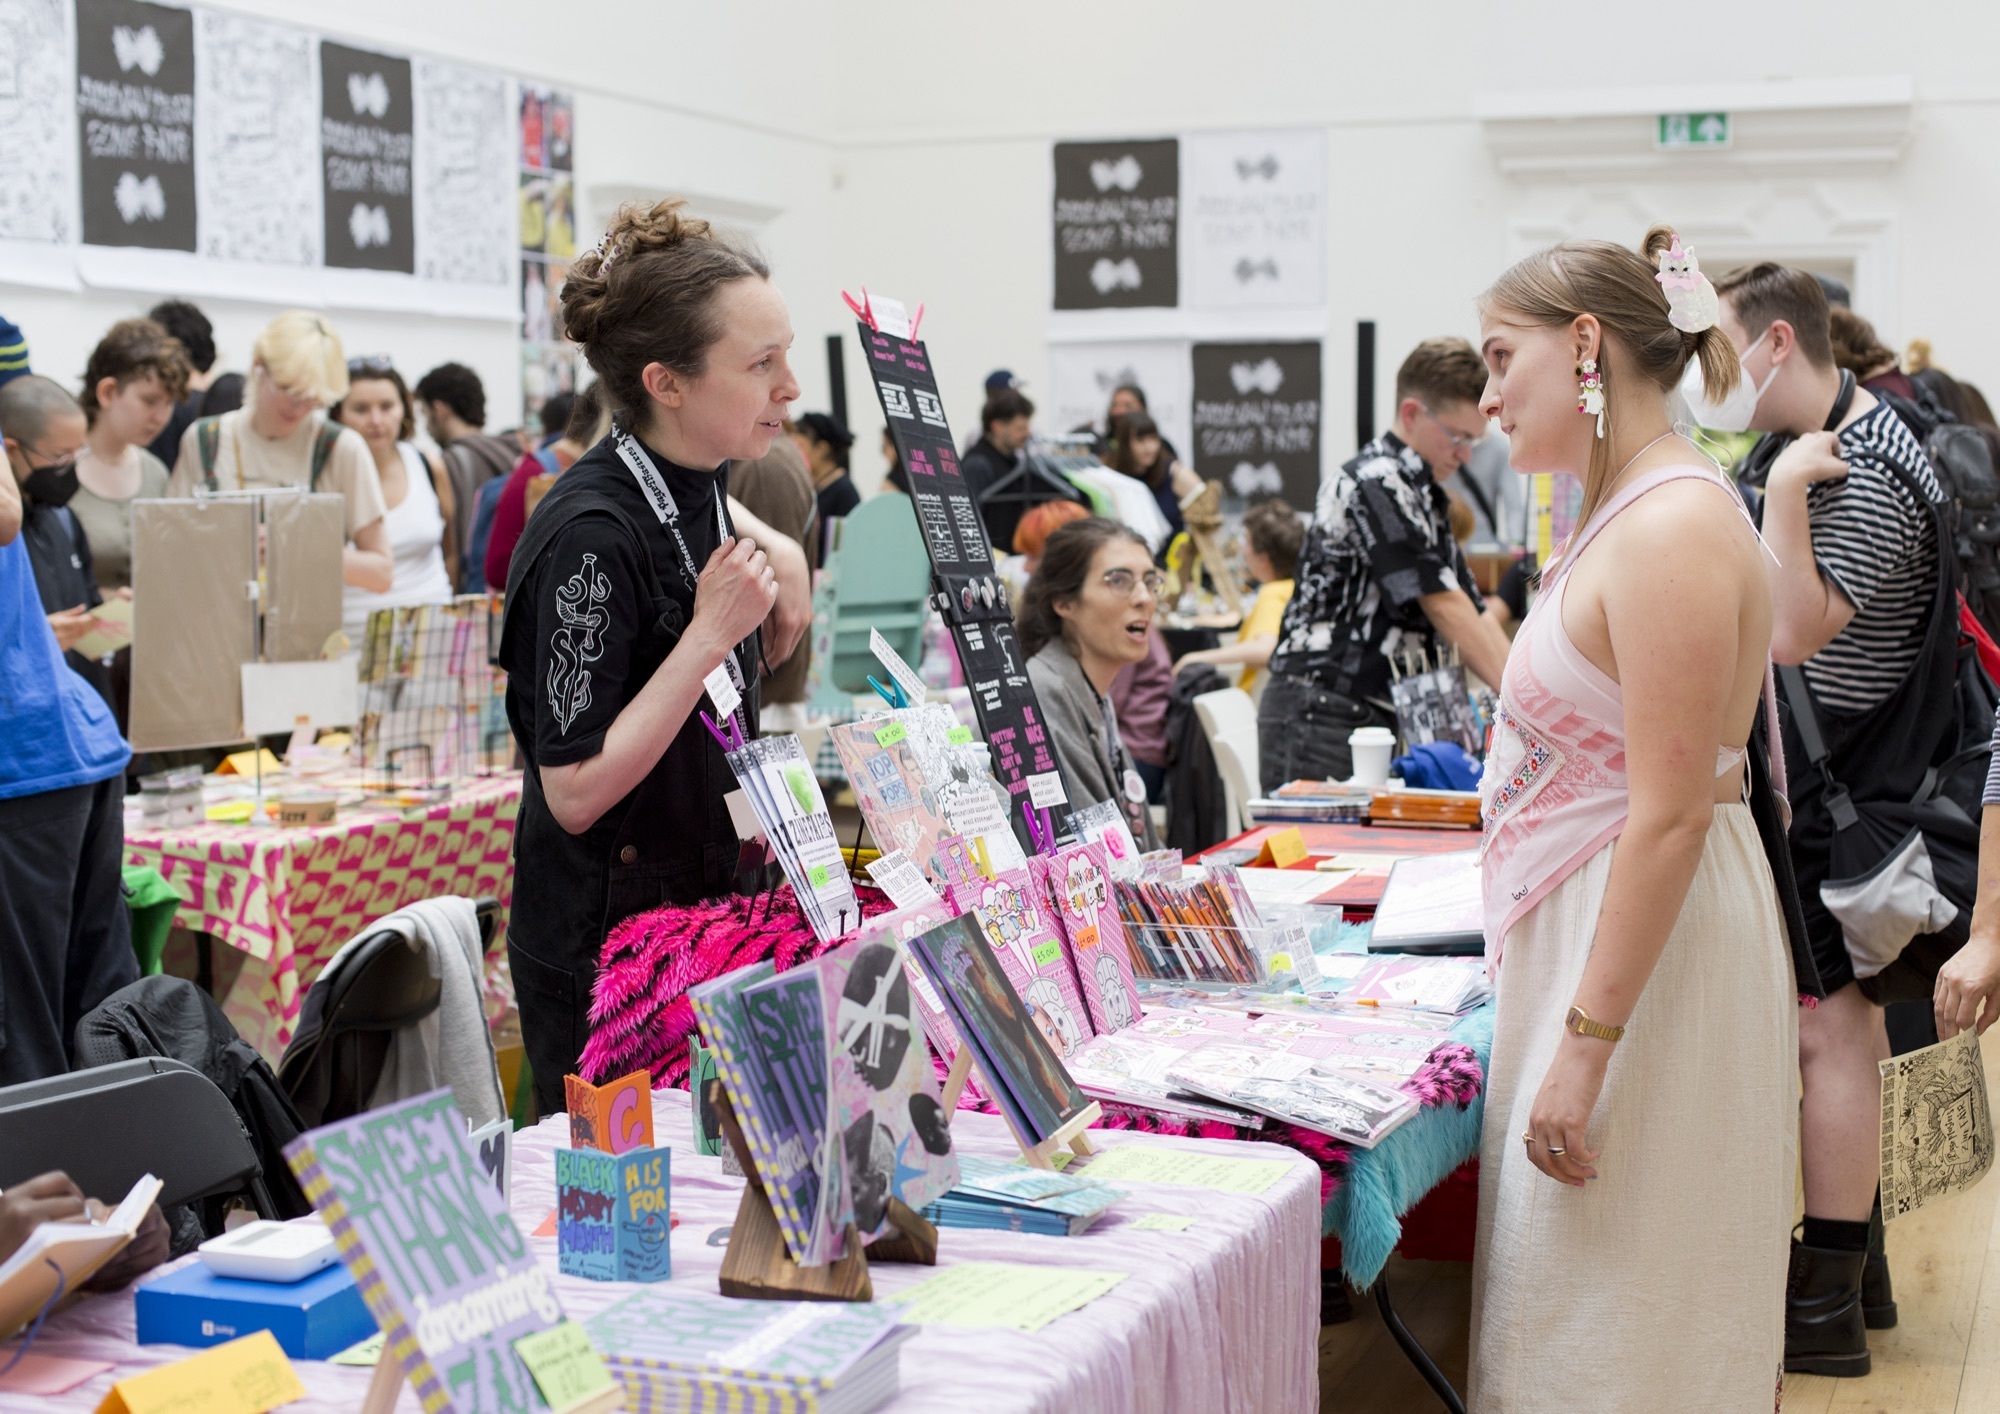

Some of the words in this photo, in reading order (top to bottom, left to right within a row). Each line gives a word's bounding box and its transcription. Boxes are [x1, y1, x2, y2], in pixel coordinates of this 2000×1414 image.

[867, 752, 892, 781] TOP
[313, 1095, 473, 1203] SWEET
[556, 1150, 617, 1194] BLACK
[625, 1163, 640, 1193] H
[644, 1157, 662, 1187] IS
[628, 1186, 667, 1222] FOR
[350, 1167, 525, 1301] THANG
[558, 1219, 615, 1255] MONTH
[413, 1262, 561, 1357] dreaming
